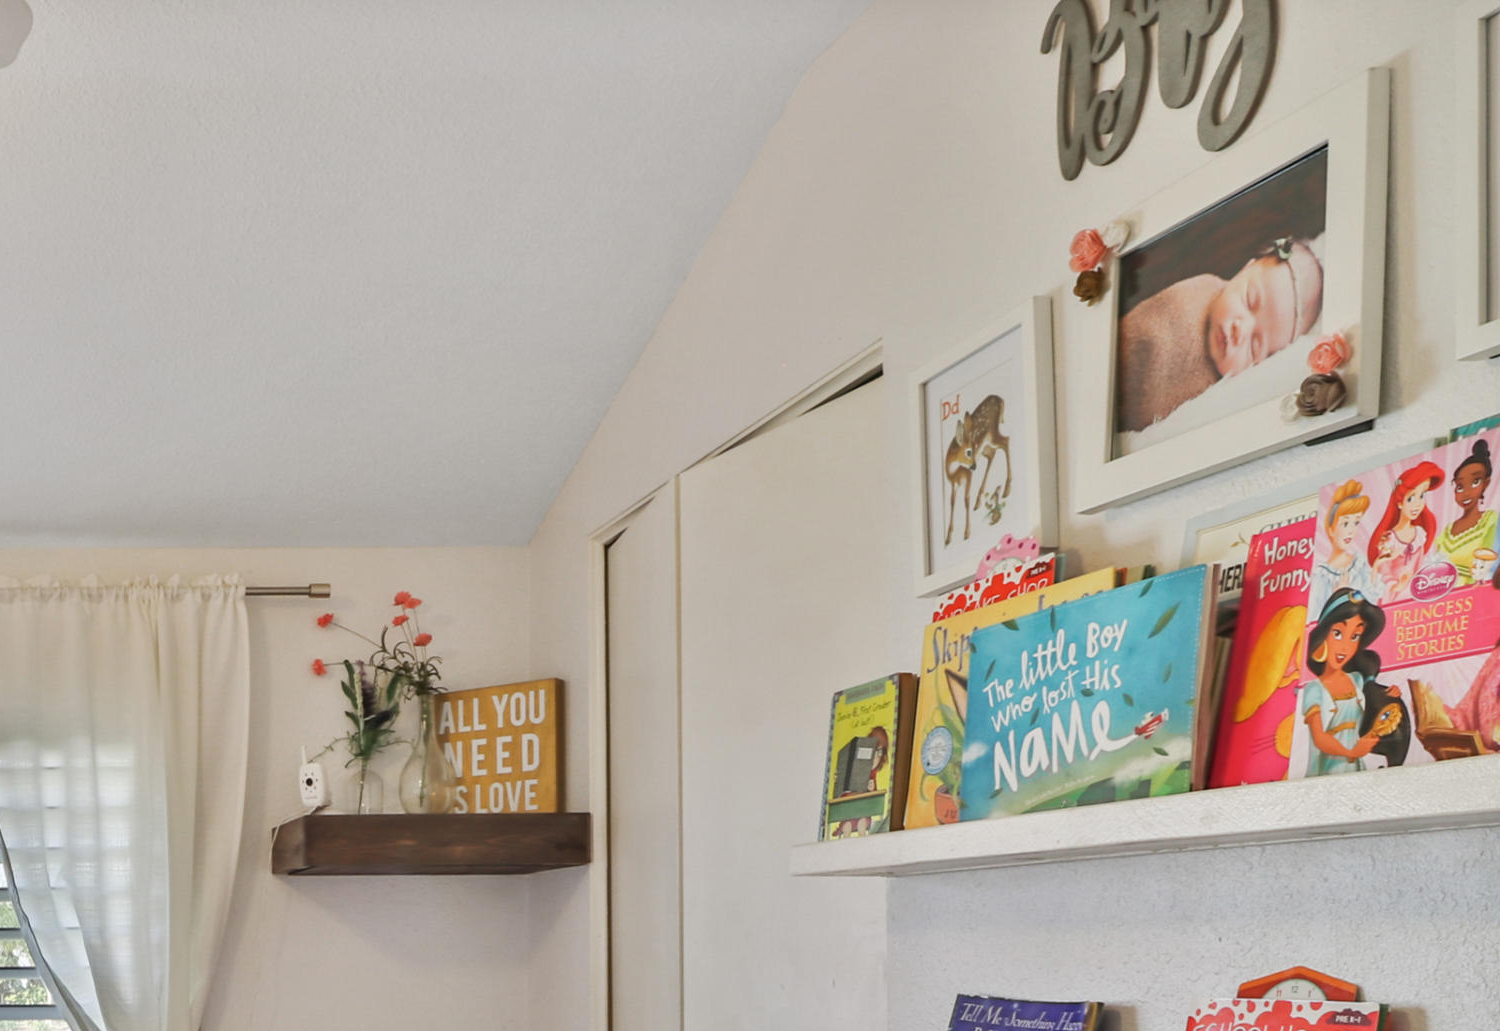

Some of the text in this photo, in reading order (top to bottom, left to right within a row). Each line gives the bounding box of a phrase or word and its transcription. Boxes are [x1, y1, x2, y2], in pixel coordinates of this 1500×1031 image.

[941, 393, 961, 421] Dd
[1264, 536, 1315, 566] Honey
[1260, 568, 1312, 599] Funny
[1393, 596, 1473, 627] PRINCESS
[1396, 615, 1468, 643] BEDTIME
[1396, 634, 1465, 661] STORIES
[1080, 659, 1123, 691] His
[983, 678, 1015, 708] The
[439, 689, 546, 735] ALL YOU
[444, 732, 541, 778] NEED
[475, 779, 539, 814] LOVE
[960, 1003, 983, 1023] Tell
[981, 1005, 1003, 1025] Me
